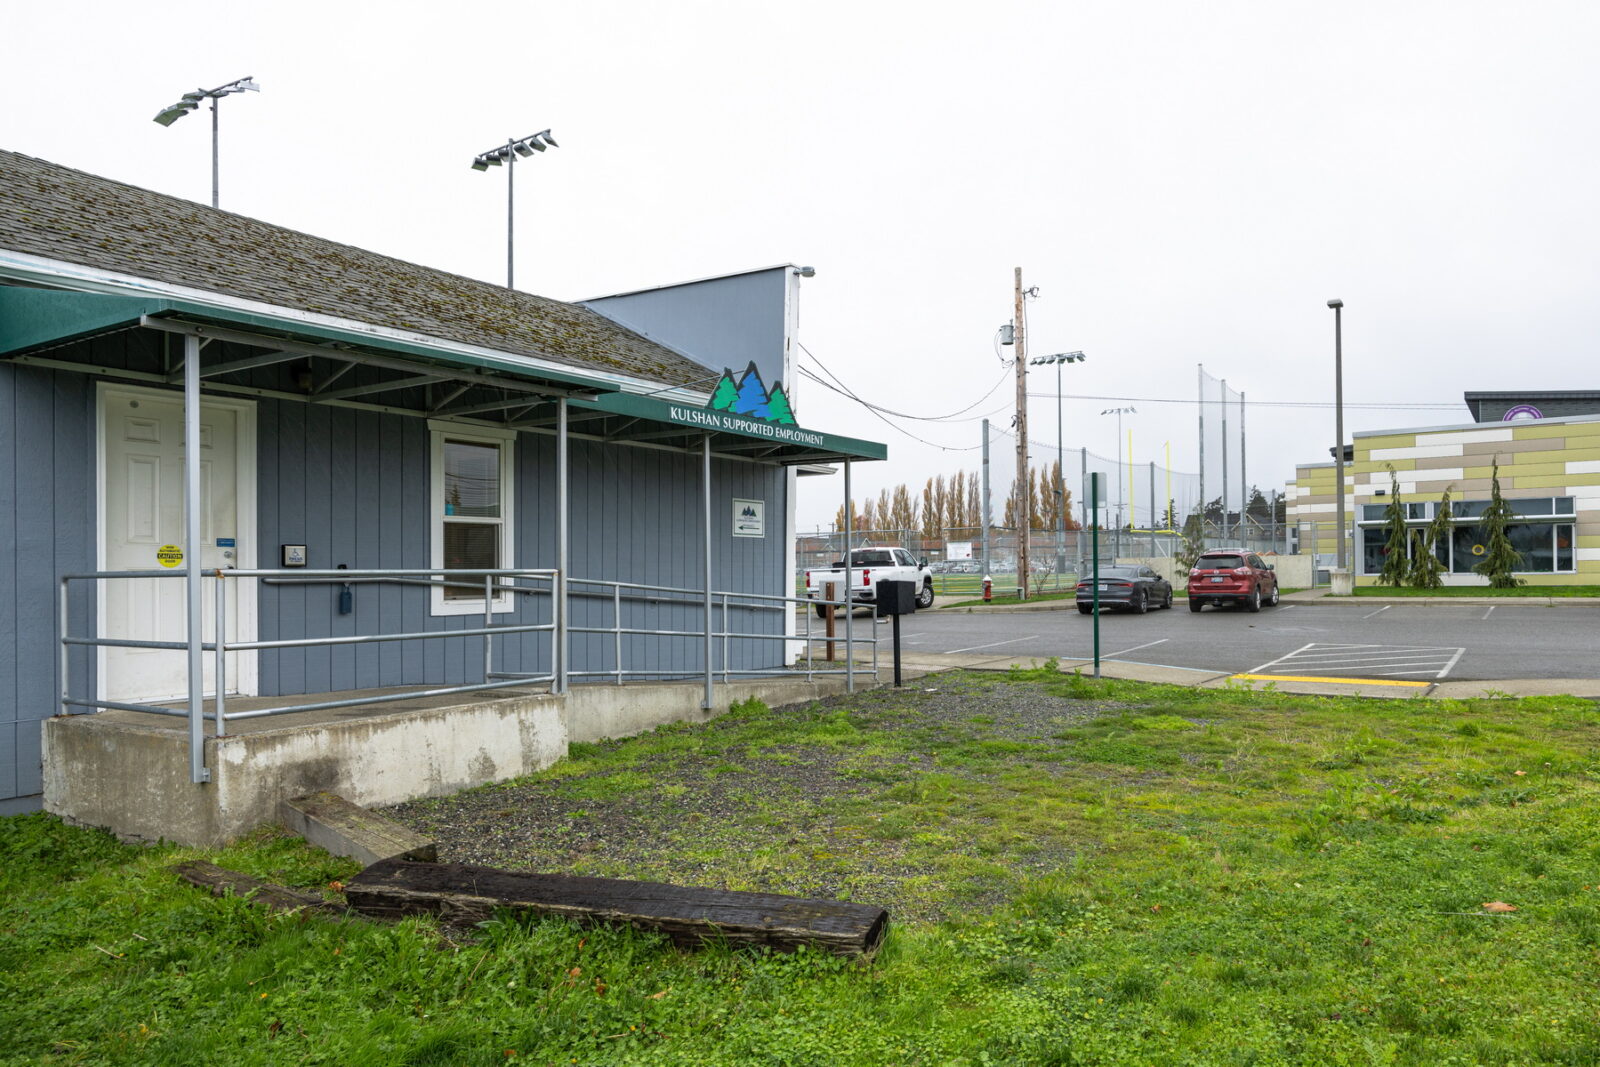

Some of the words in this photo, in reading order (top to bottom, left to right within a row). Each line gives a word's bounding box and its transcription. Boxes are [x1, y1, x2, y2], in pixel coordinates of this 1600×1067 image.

[670, 406, 720, 427] KULSHAN
[722, 416, 774, 437] SUPPORTED
[775, 427, 824, 446] EMPLOYMENT
